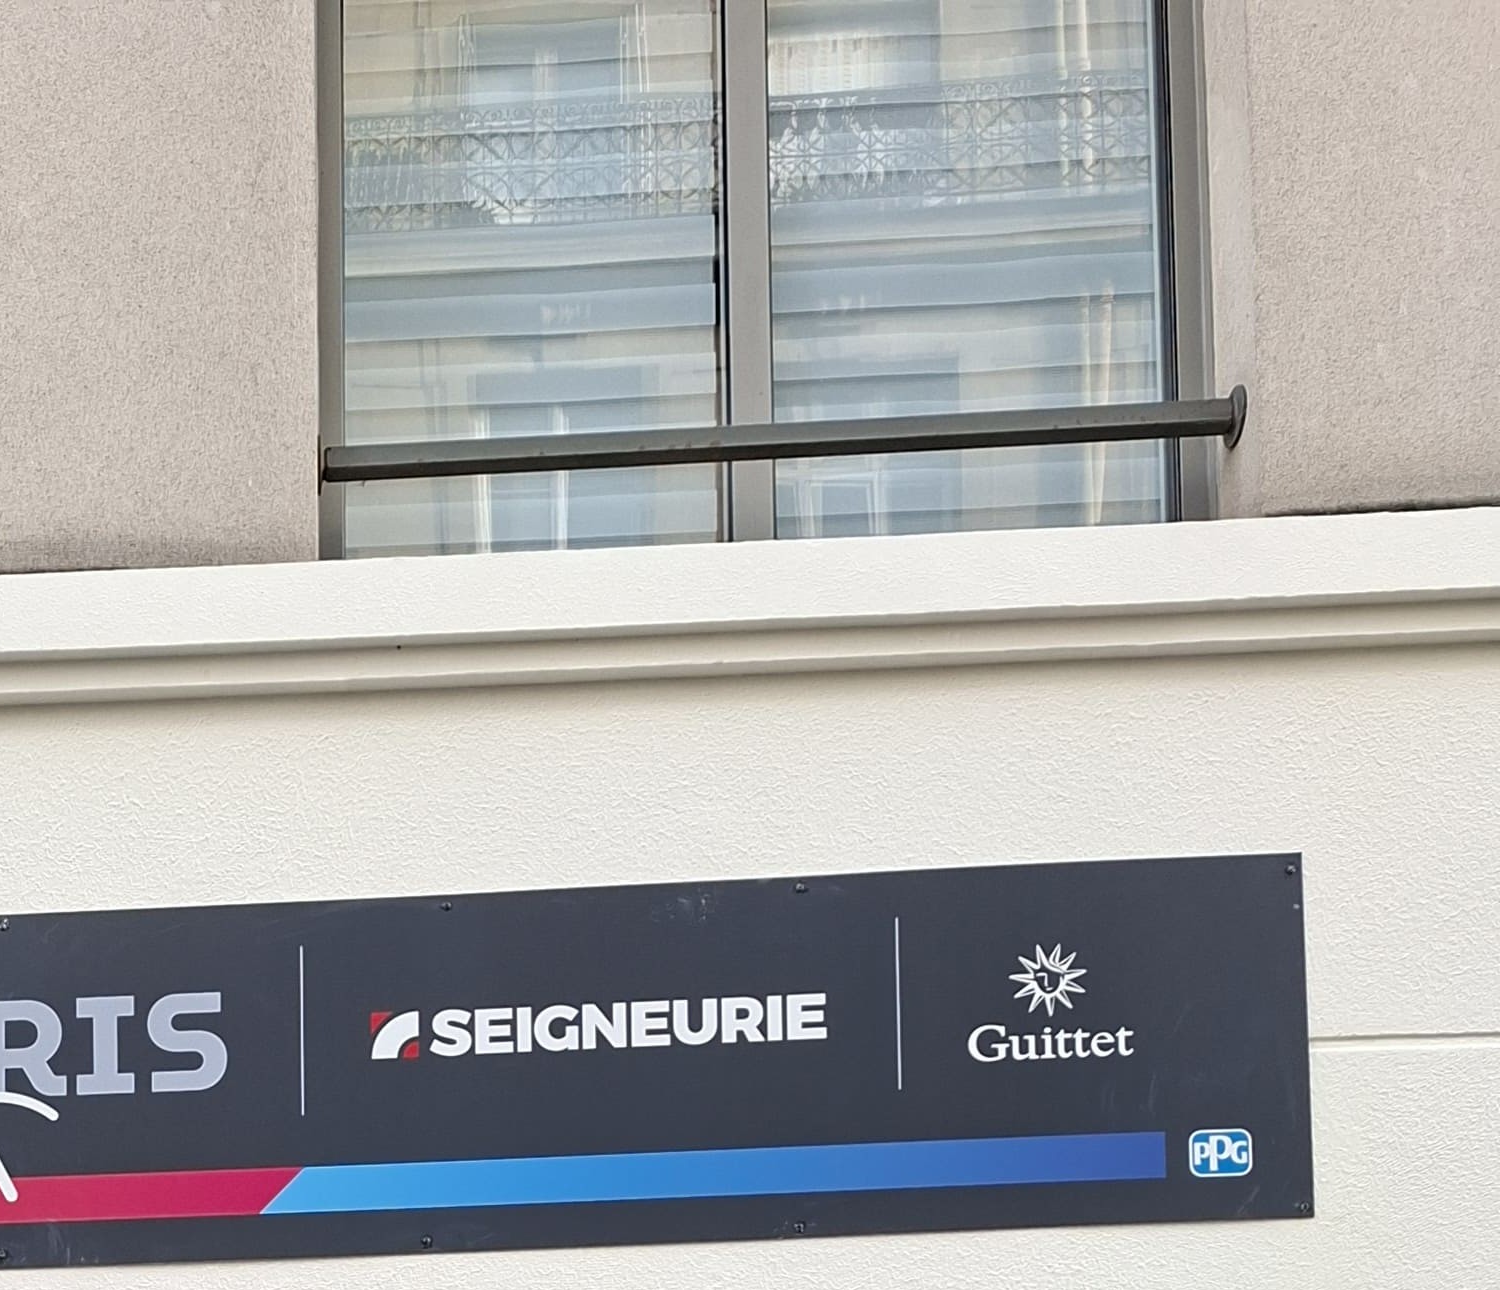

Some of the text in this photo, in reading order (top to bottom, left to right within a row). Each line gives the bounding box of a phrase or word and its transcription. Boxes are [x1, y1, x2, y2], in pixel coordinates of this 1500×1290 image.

[429, 992, 828, 1057] SEIGNEURIE
[967, 1020, 1134, 1062] Guittet
[1192, 1133, 1251, 1174] PPG
